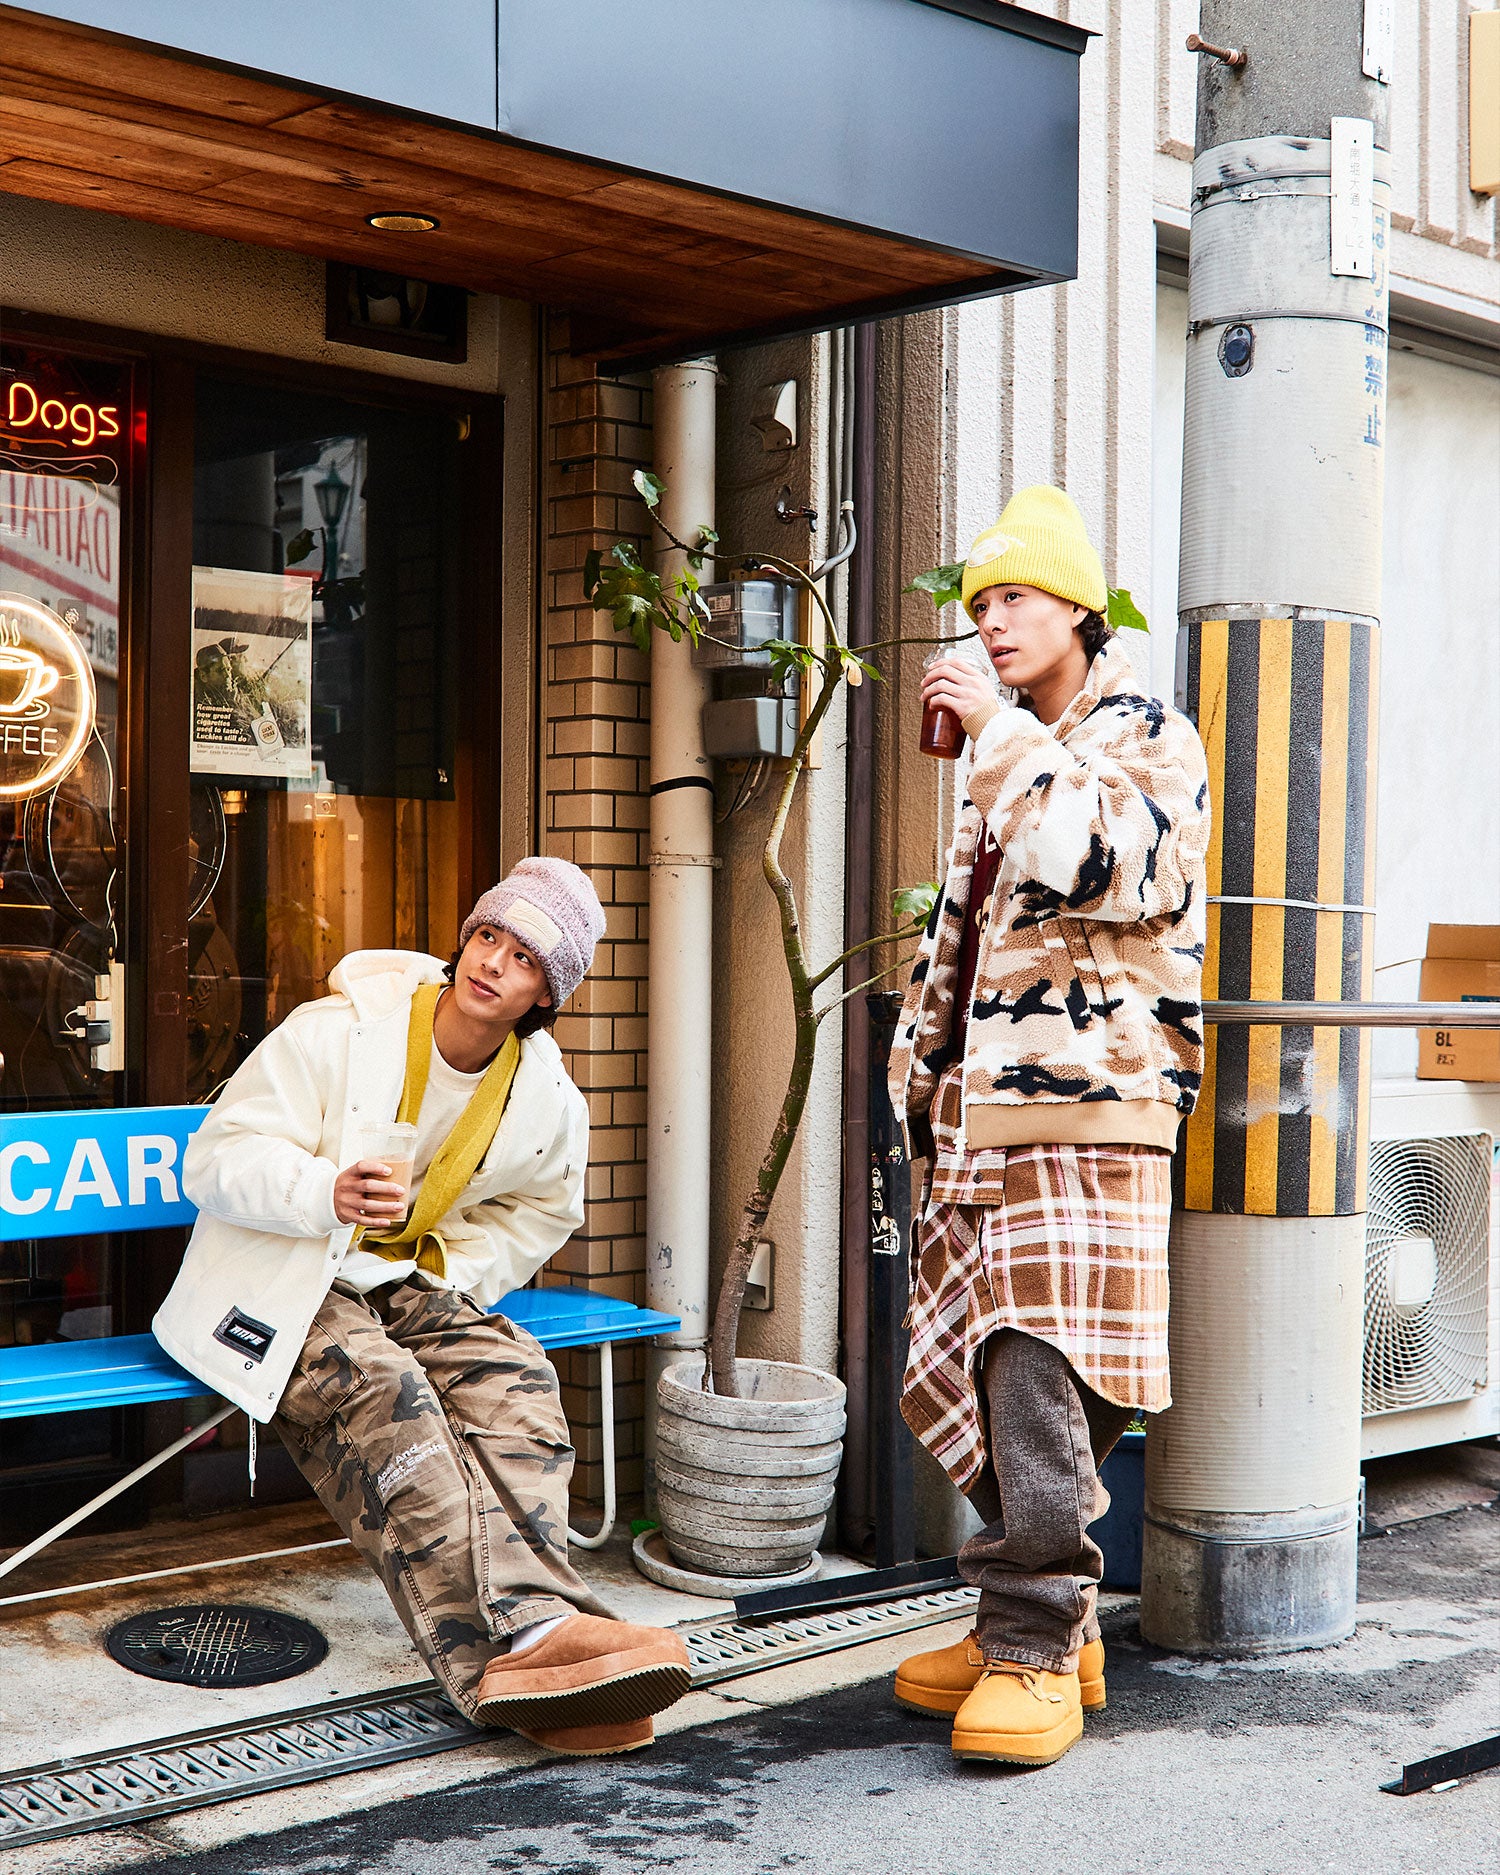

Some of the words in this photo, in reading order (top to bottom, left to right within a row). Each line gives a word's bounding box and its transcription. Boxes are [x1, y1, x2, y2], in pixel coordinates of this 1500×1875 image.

[8, 382, 119, 446] Dogs
[196, 703, 234, 713] Remember
[196, 718, 231, 727] cigarettes
[0, 724, 58, 757] FEE
[196, 732, 223, 741] Luckies
[223, 734, 238, 742] still
[238, 735, 247, 743] do
[1435, 1031, 1453, 1047] 8L
[0, 1131, 196, 1216] CAR
[395, 1442, 419, 1465] And
